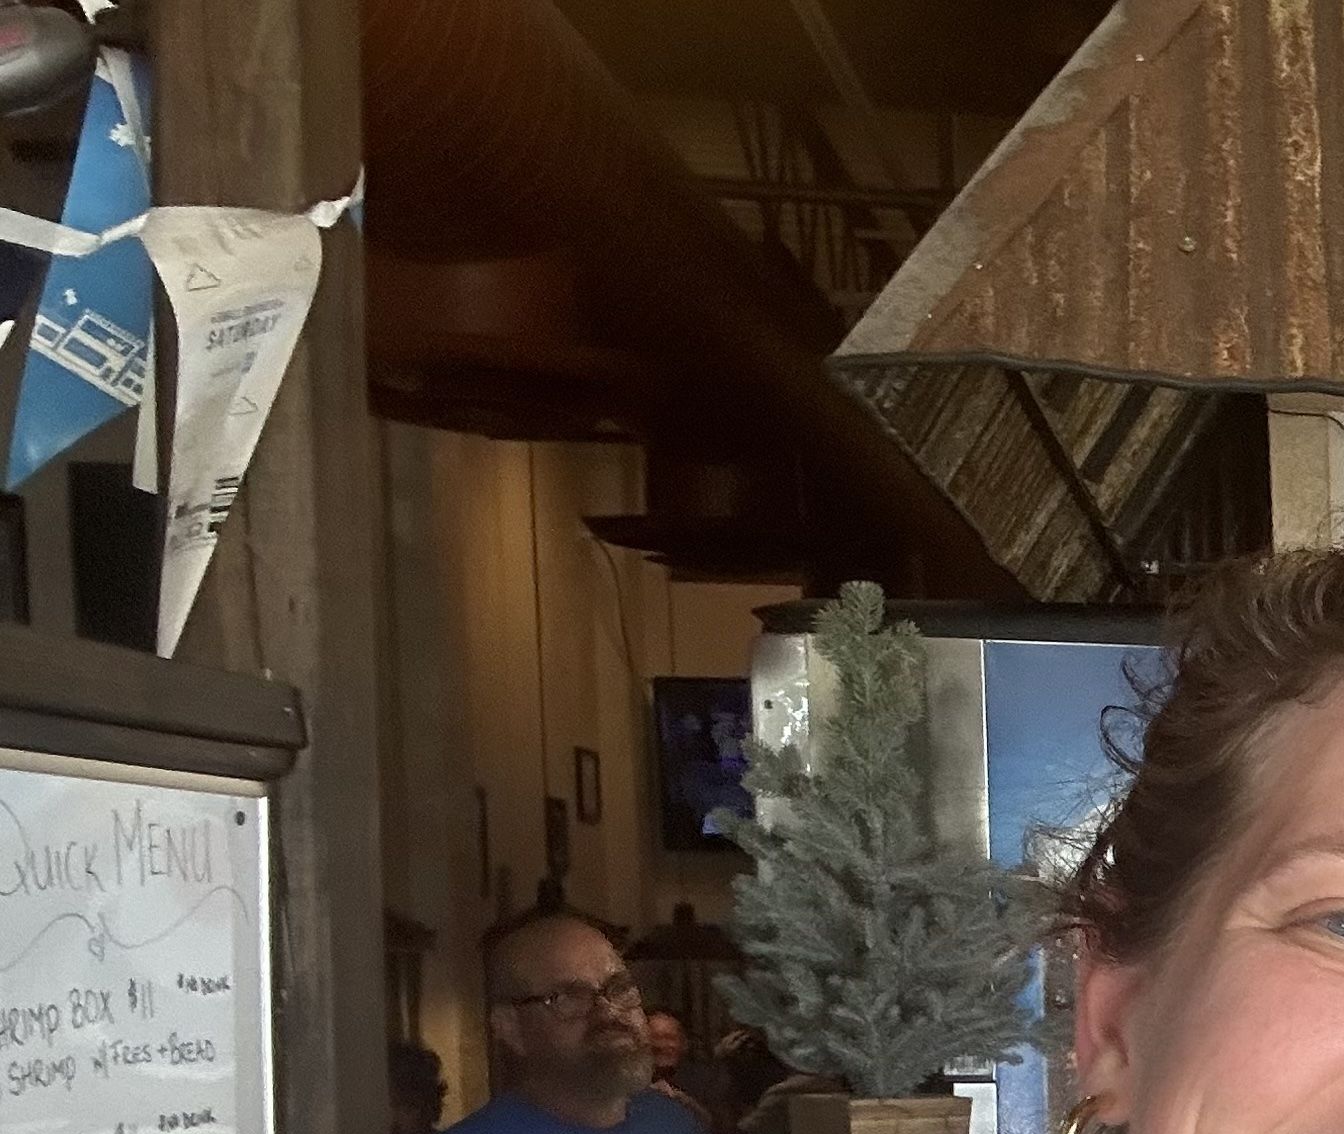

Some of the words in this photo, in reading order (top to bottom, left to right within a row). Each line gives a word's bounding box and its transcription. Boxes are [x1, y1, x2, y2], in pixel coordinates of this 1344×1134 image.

[206, 313, 281, 350] SATURDAY
[112, 799, 215, 886] MENU
[70, 988, 114, 1028] BOX
